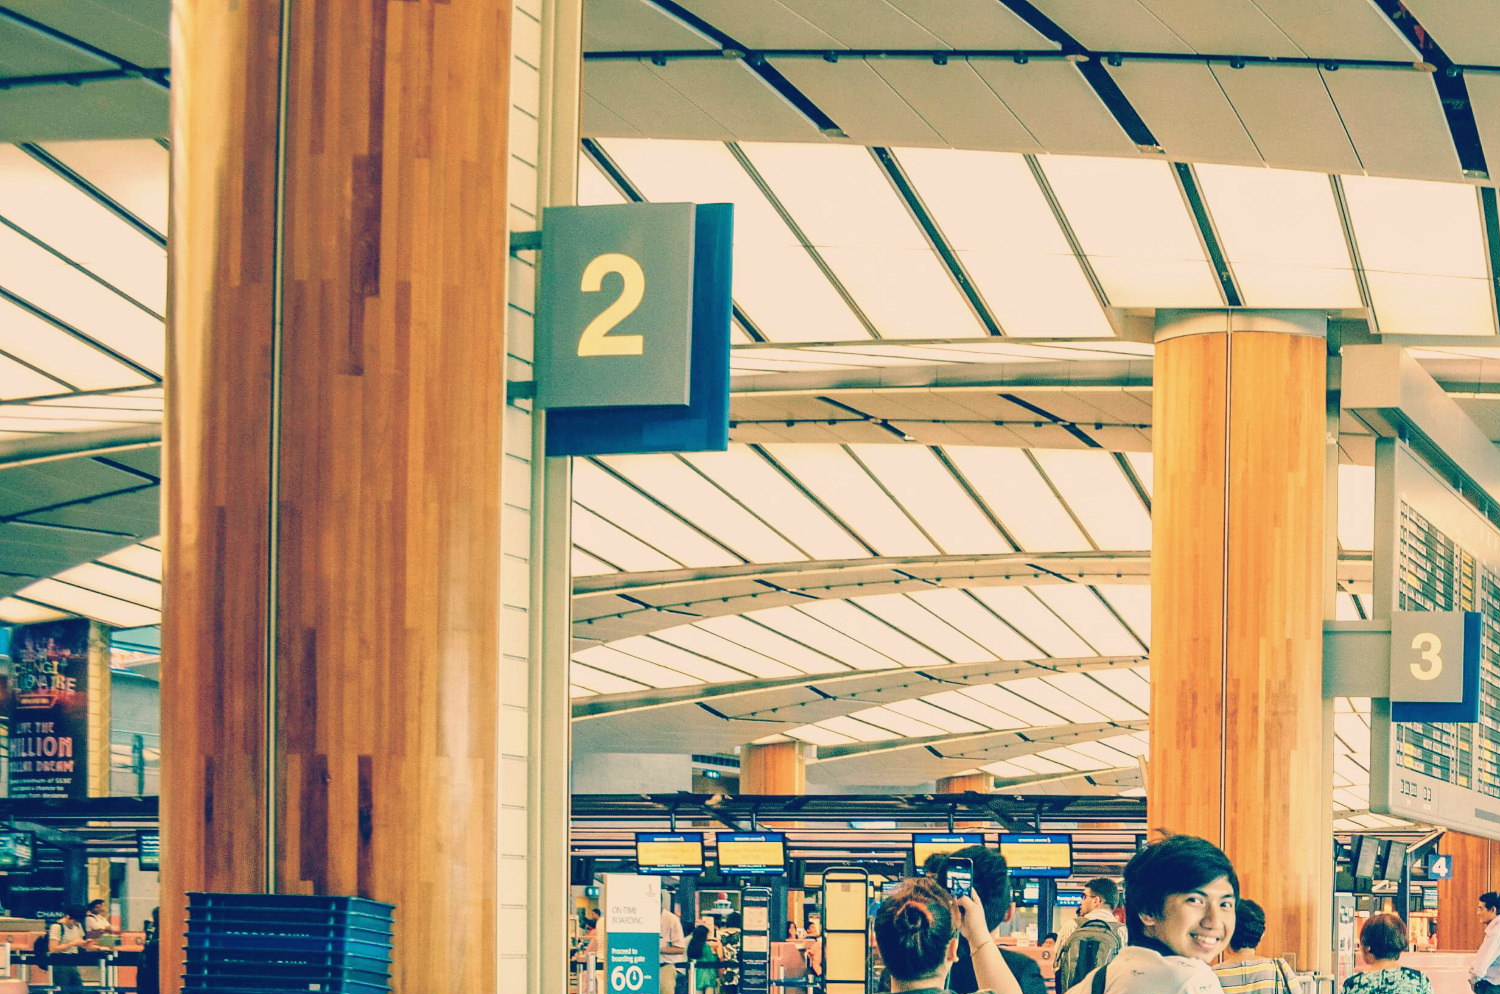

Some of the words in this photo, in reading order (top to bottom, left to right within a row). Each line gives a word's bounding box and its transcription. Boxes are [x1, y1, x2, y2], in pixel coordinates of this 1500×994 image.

[578, 253, 645, 357] 2
[1409, 632, 1443, 681] 3
[10, 736, 73, 757] MILLION
[1432, 857, 1448, 876] 4
[612, 906, 637, 914] ON-TIME
[612, 916, 643, 924] BOARDING
[611, 947, 632, 955] Proceed
[611, 965, 644, 991] 60
